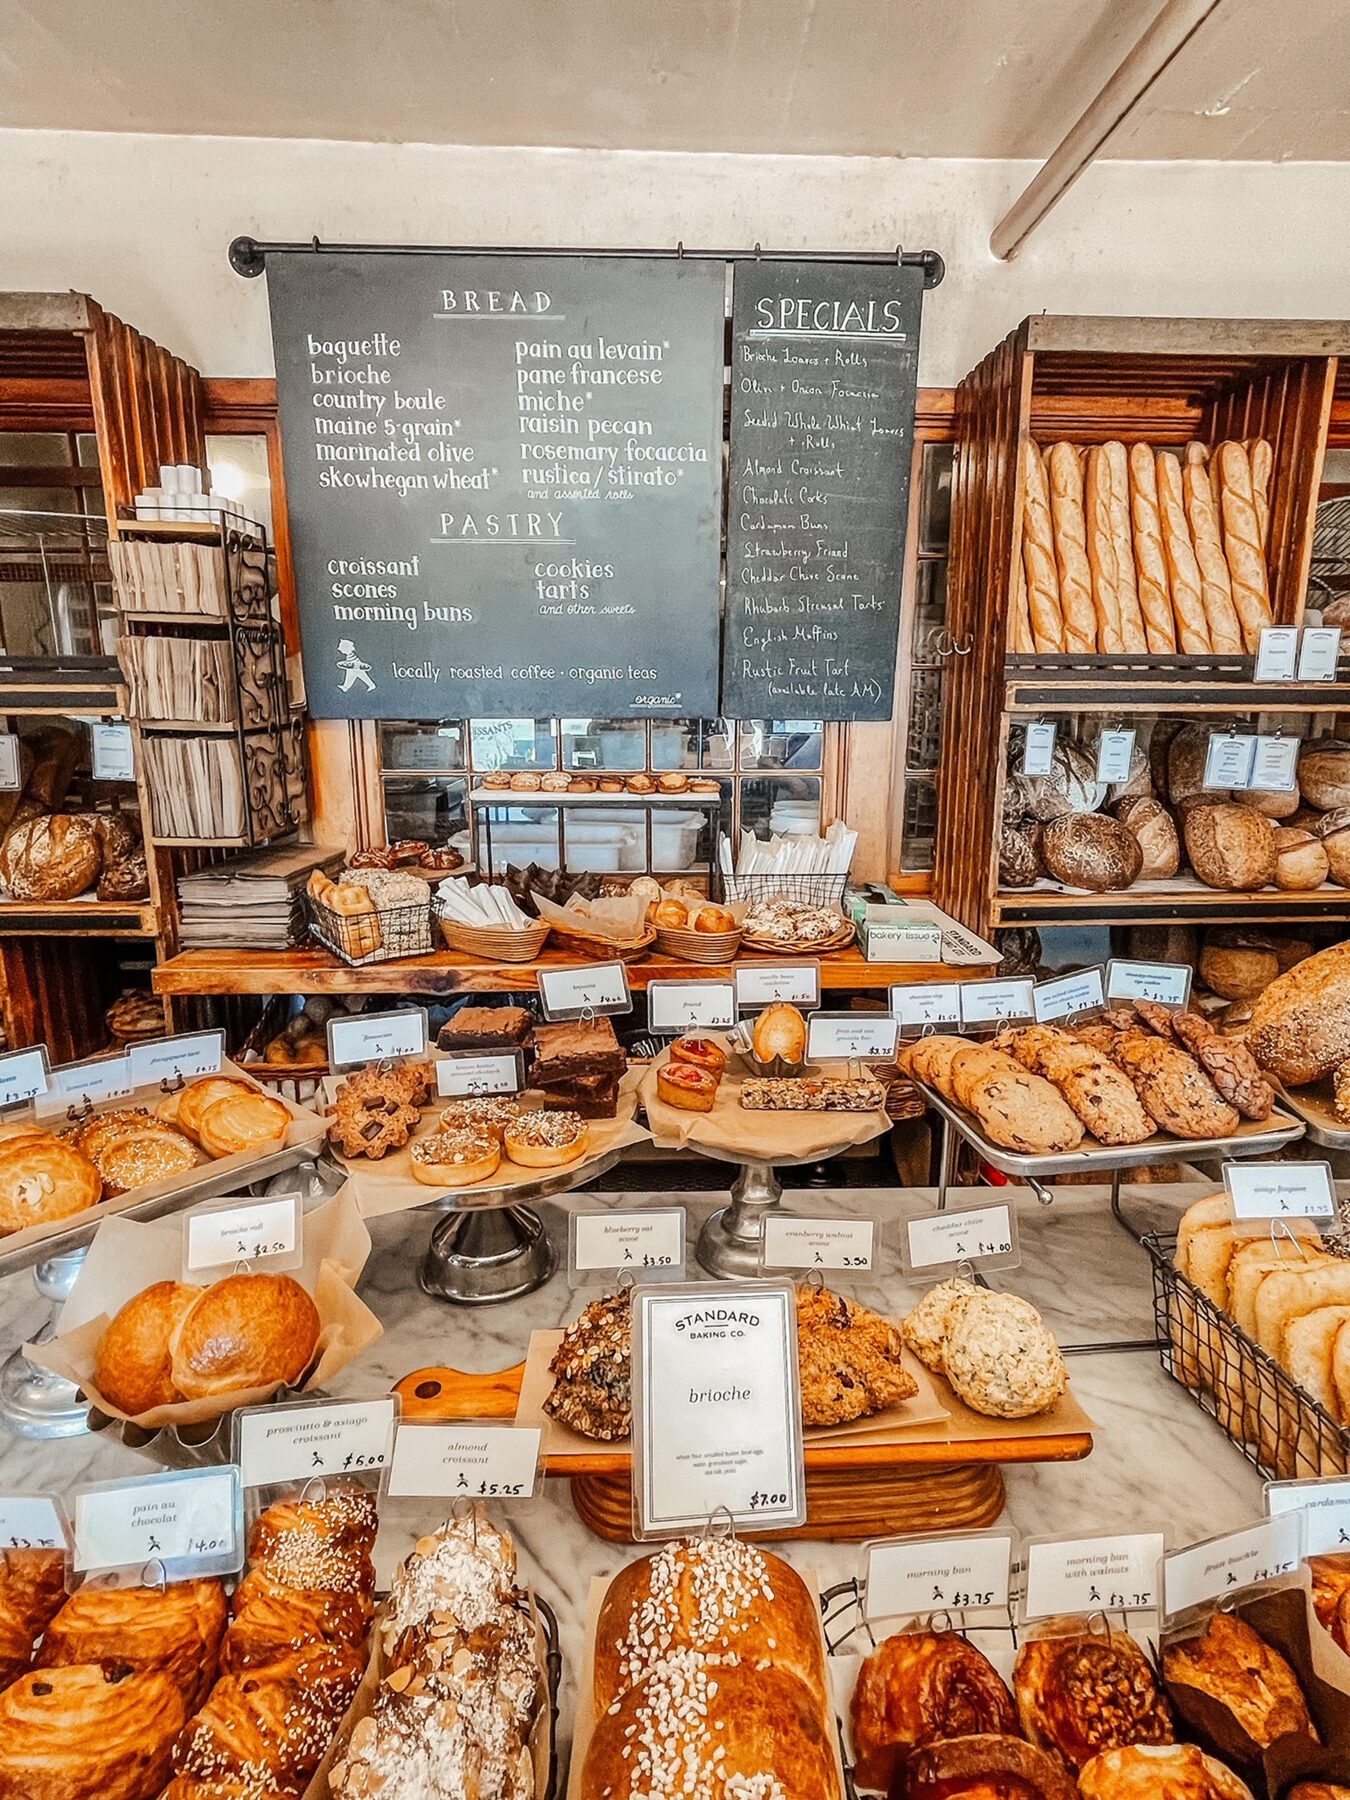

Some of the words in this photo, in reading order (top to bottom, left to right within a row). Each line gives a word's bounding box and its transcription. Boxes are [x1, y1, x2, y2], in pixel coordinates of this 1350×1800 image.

[441, 289, 551, 312] BREAD
[756, 298, 902, 332] SPECIALS
[307, 333, 401, 364] baguette
[515, 340, 562, 364] pain
[567, 343, 593, 359] au
[835, 349, 867, 367] Rolls
[311, 363, 391, 384] brioche
[517, 369, 565, 392] pane
[570, 362, 662, 384] francese
[313, 390, 386, 417] country
[394, 388, 446, 409] boule
[315, 416, 377, 435] maine
[519, 414, 579, 433] raisin
[588, 418, 653, 441] pecan
[315, 441, 421, 461] marinated
[427, 441, 474, 462] olive
[520, 443, 619, 468] rosemary
[624, 438, 708, 462] focaccia
[742, 458, 783, 476] Almond
[319, 465, 429, 497] skowhegan
[527, 489, 548, 499] and
[554, 489, 600, 499] assorted
[605, 489, 634, 500] rolls
[441, 512, 563, 537] PASTRY
[800, 513, 828, 530] Buns
[327, 556, 419, 576] croissant
[535, 558, 615, 578] cookies
[741, 567, 785, 584] Cheddar
[332, 582, 397, 598] scones
[536, 580, 590, 600] tarts
[333, 602, 417, 630] morning
[423, 601, 473, 622] buns
[540, 604, 564, 615] and
[567, 603, 596, 615] other
[600, 604, 636, 615] sweets
[392, 662, 441, 683] locally
[450, 665, 503, 679] roasted
[510, 665, 556, 680] coffee
[569, 667, 624, 684] organic
[628, 665, 657, 680] teas
[743, 659, 783, 679] Rustic
[870, 931, 901, 941] bakery
[905, 932, 930, 940] tissue
[786, 1231, 824, 1239] cranberry
[642, 1254, 672, 1267] $3.50
[675, 1309, 760, 1331] STANDARD
[690, 1331, 726, 1340] BAKING
[730, 1330, 746, 1338] CO.
[689, 1386, 751, 1403] brioche
[266, 1422, 321, 1438] prosciutto
[322, 1420, 331, 1429] &
[333, 1416, 368, 1428] asiago
[292, 1431, 342, 1445] croissant
[447, 1442, 488, 1452] almond
[342, 1452, 385, 1470] $6.00
[442, 1455, 489, 1465] croissant
[477, 1480, 525, 1495] $5.25
[132, 1503, 159, 1516] pain
[160, 1502, 176, 1510] au
[749, 1491, 787, 1509] $7.00
[131, 1513, 177, 1527] chocolat
[1066, 1553, 1108, 1566] morning
[1110, 1552, 1129, 1562] bun
[906, 1566, 950, 1580] morning
[952, 1566, 972, 1575] bun
[1065, 1568, 1088, 1578] with
[1089, 1564, 1129, 1576] walnuts
[952, 1592, 994, 1606] $3.75
[1110, 1592, 1151, 1607] $3.75
